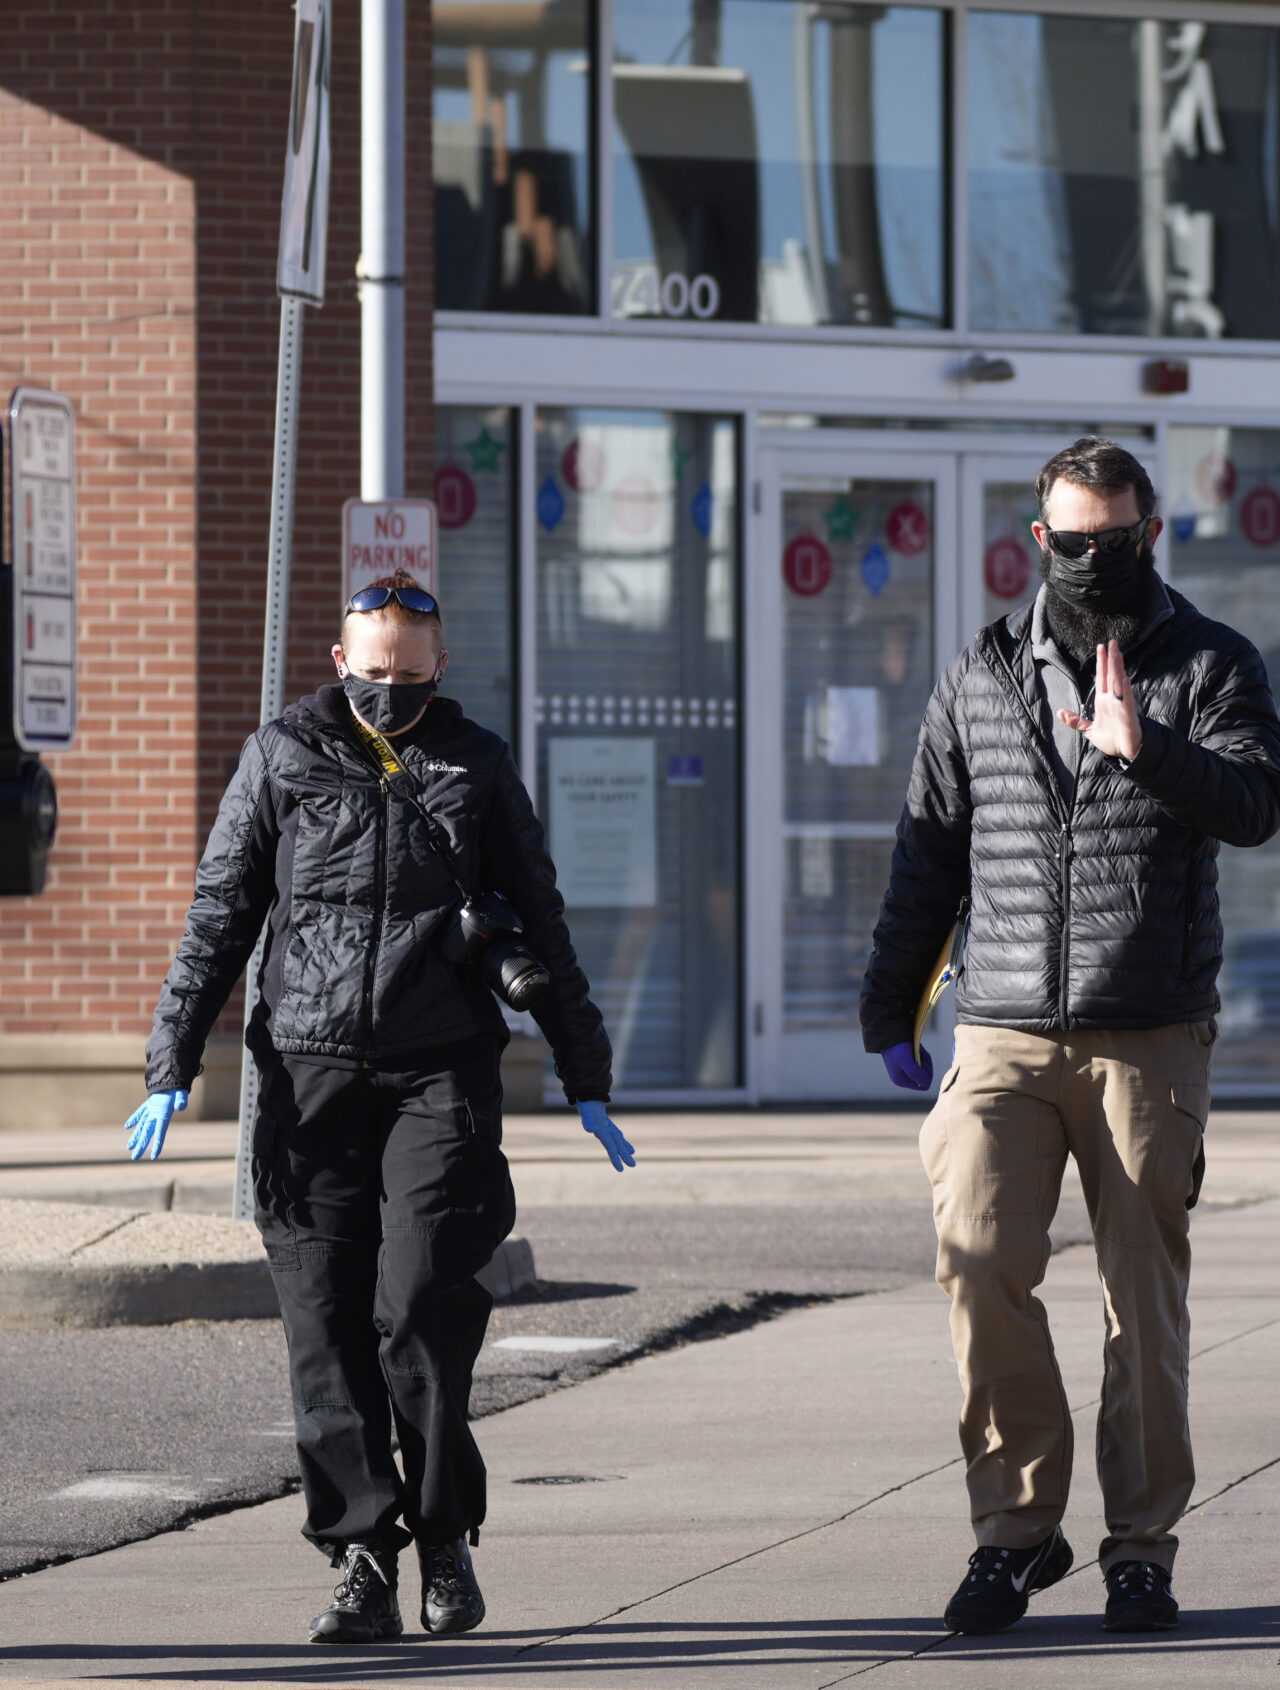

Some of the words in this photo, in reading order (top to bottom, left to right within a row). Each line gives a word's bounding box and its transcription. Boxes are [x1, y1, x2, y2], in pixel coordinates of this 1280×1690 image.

[374, 513, 406, 540] NO
[351, 544, 429, 572] PARKING
[372, 739, 401, 775] Nikon
